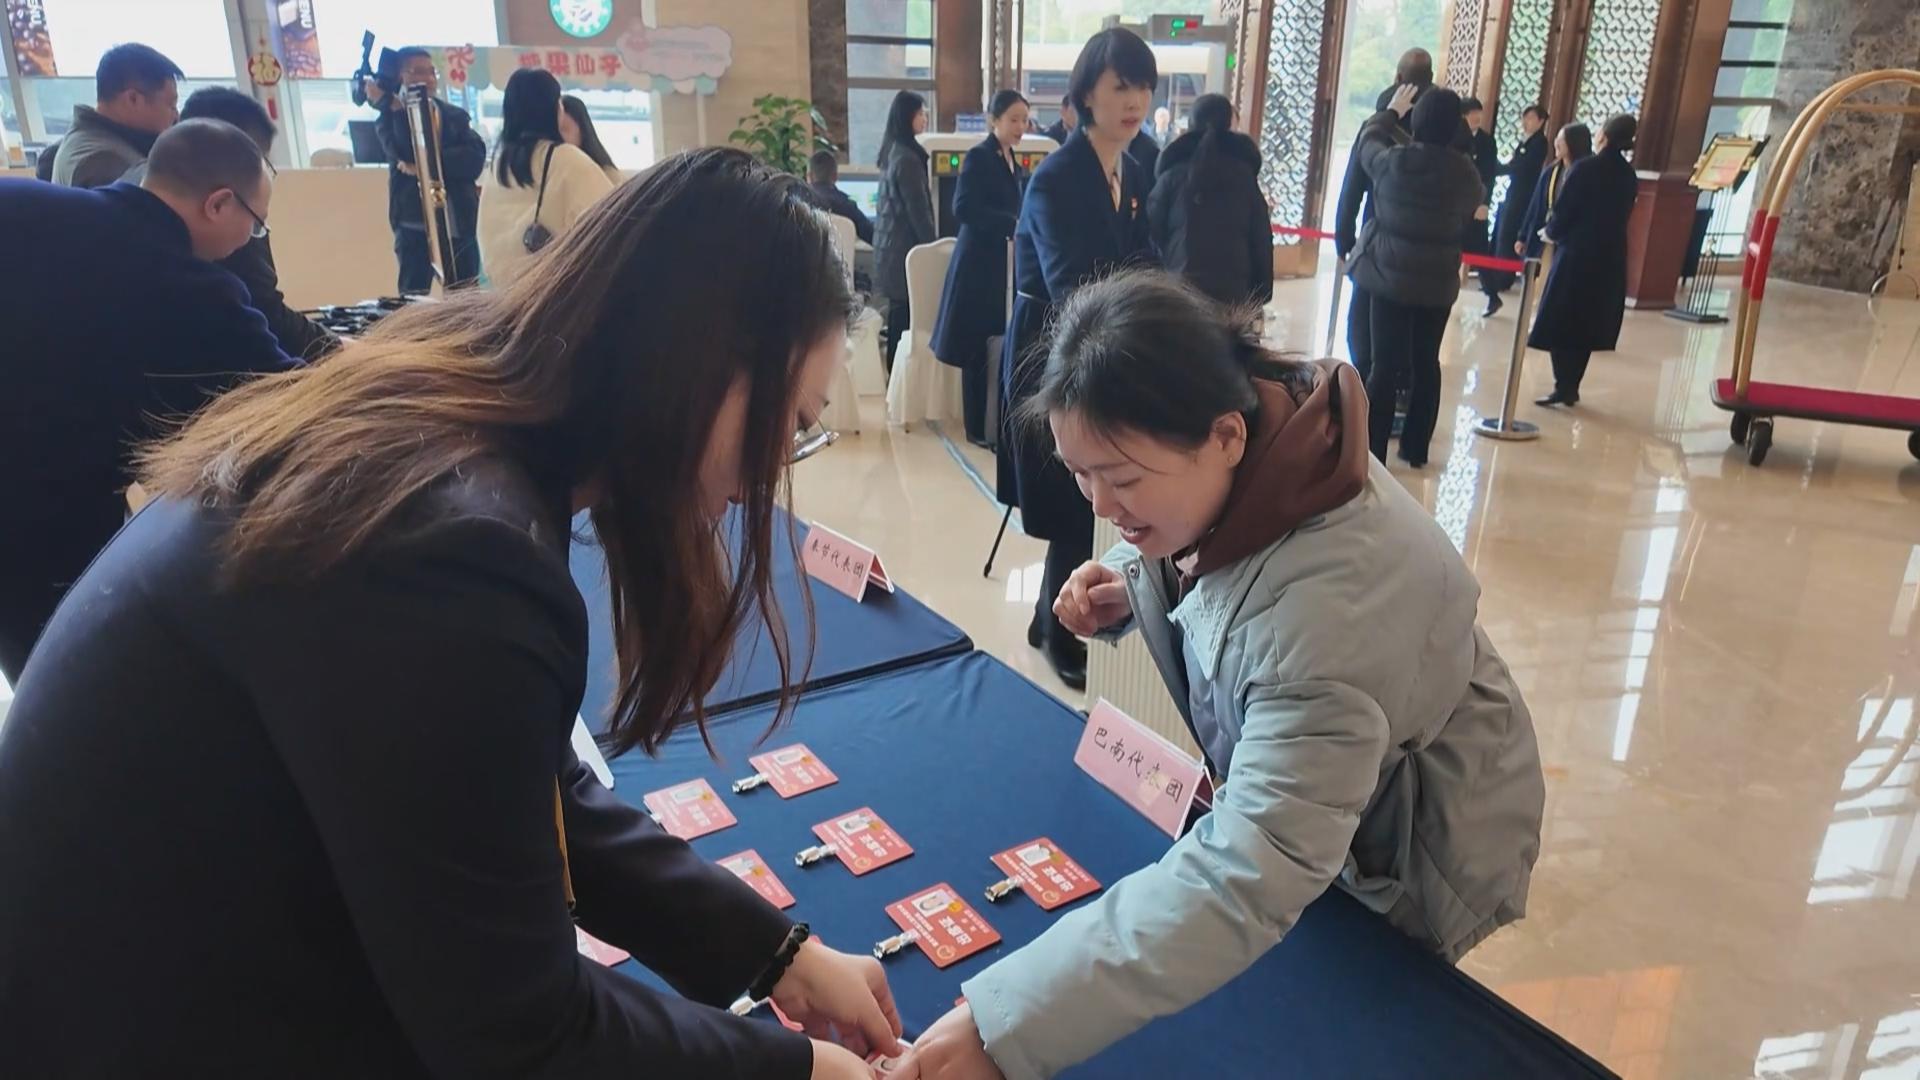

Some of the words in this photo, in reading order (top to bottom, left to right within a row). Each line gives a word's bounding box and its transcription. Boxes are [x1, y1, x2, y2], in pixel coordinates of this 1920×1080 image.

[1094, 726, 1184, 804] 巴南代表团
